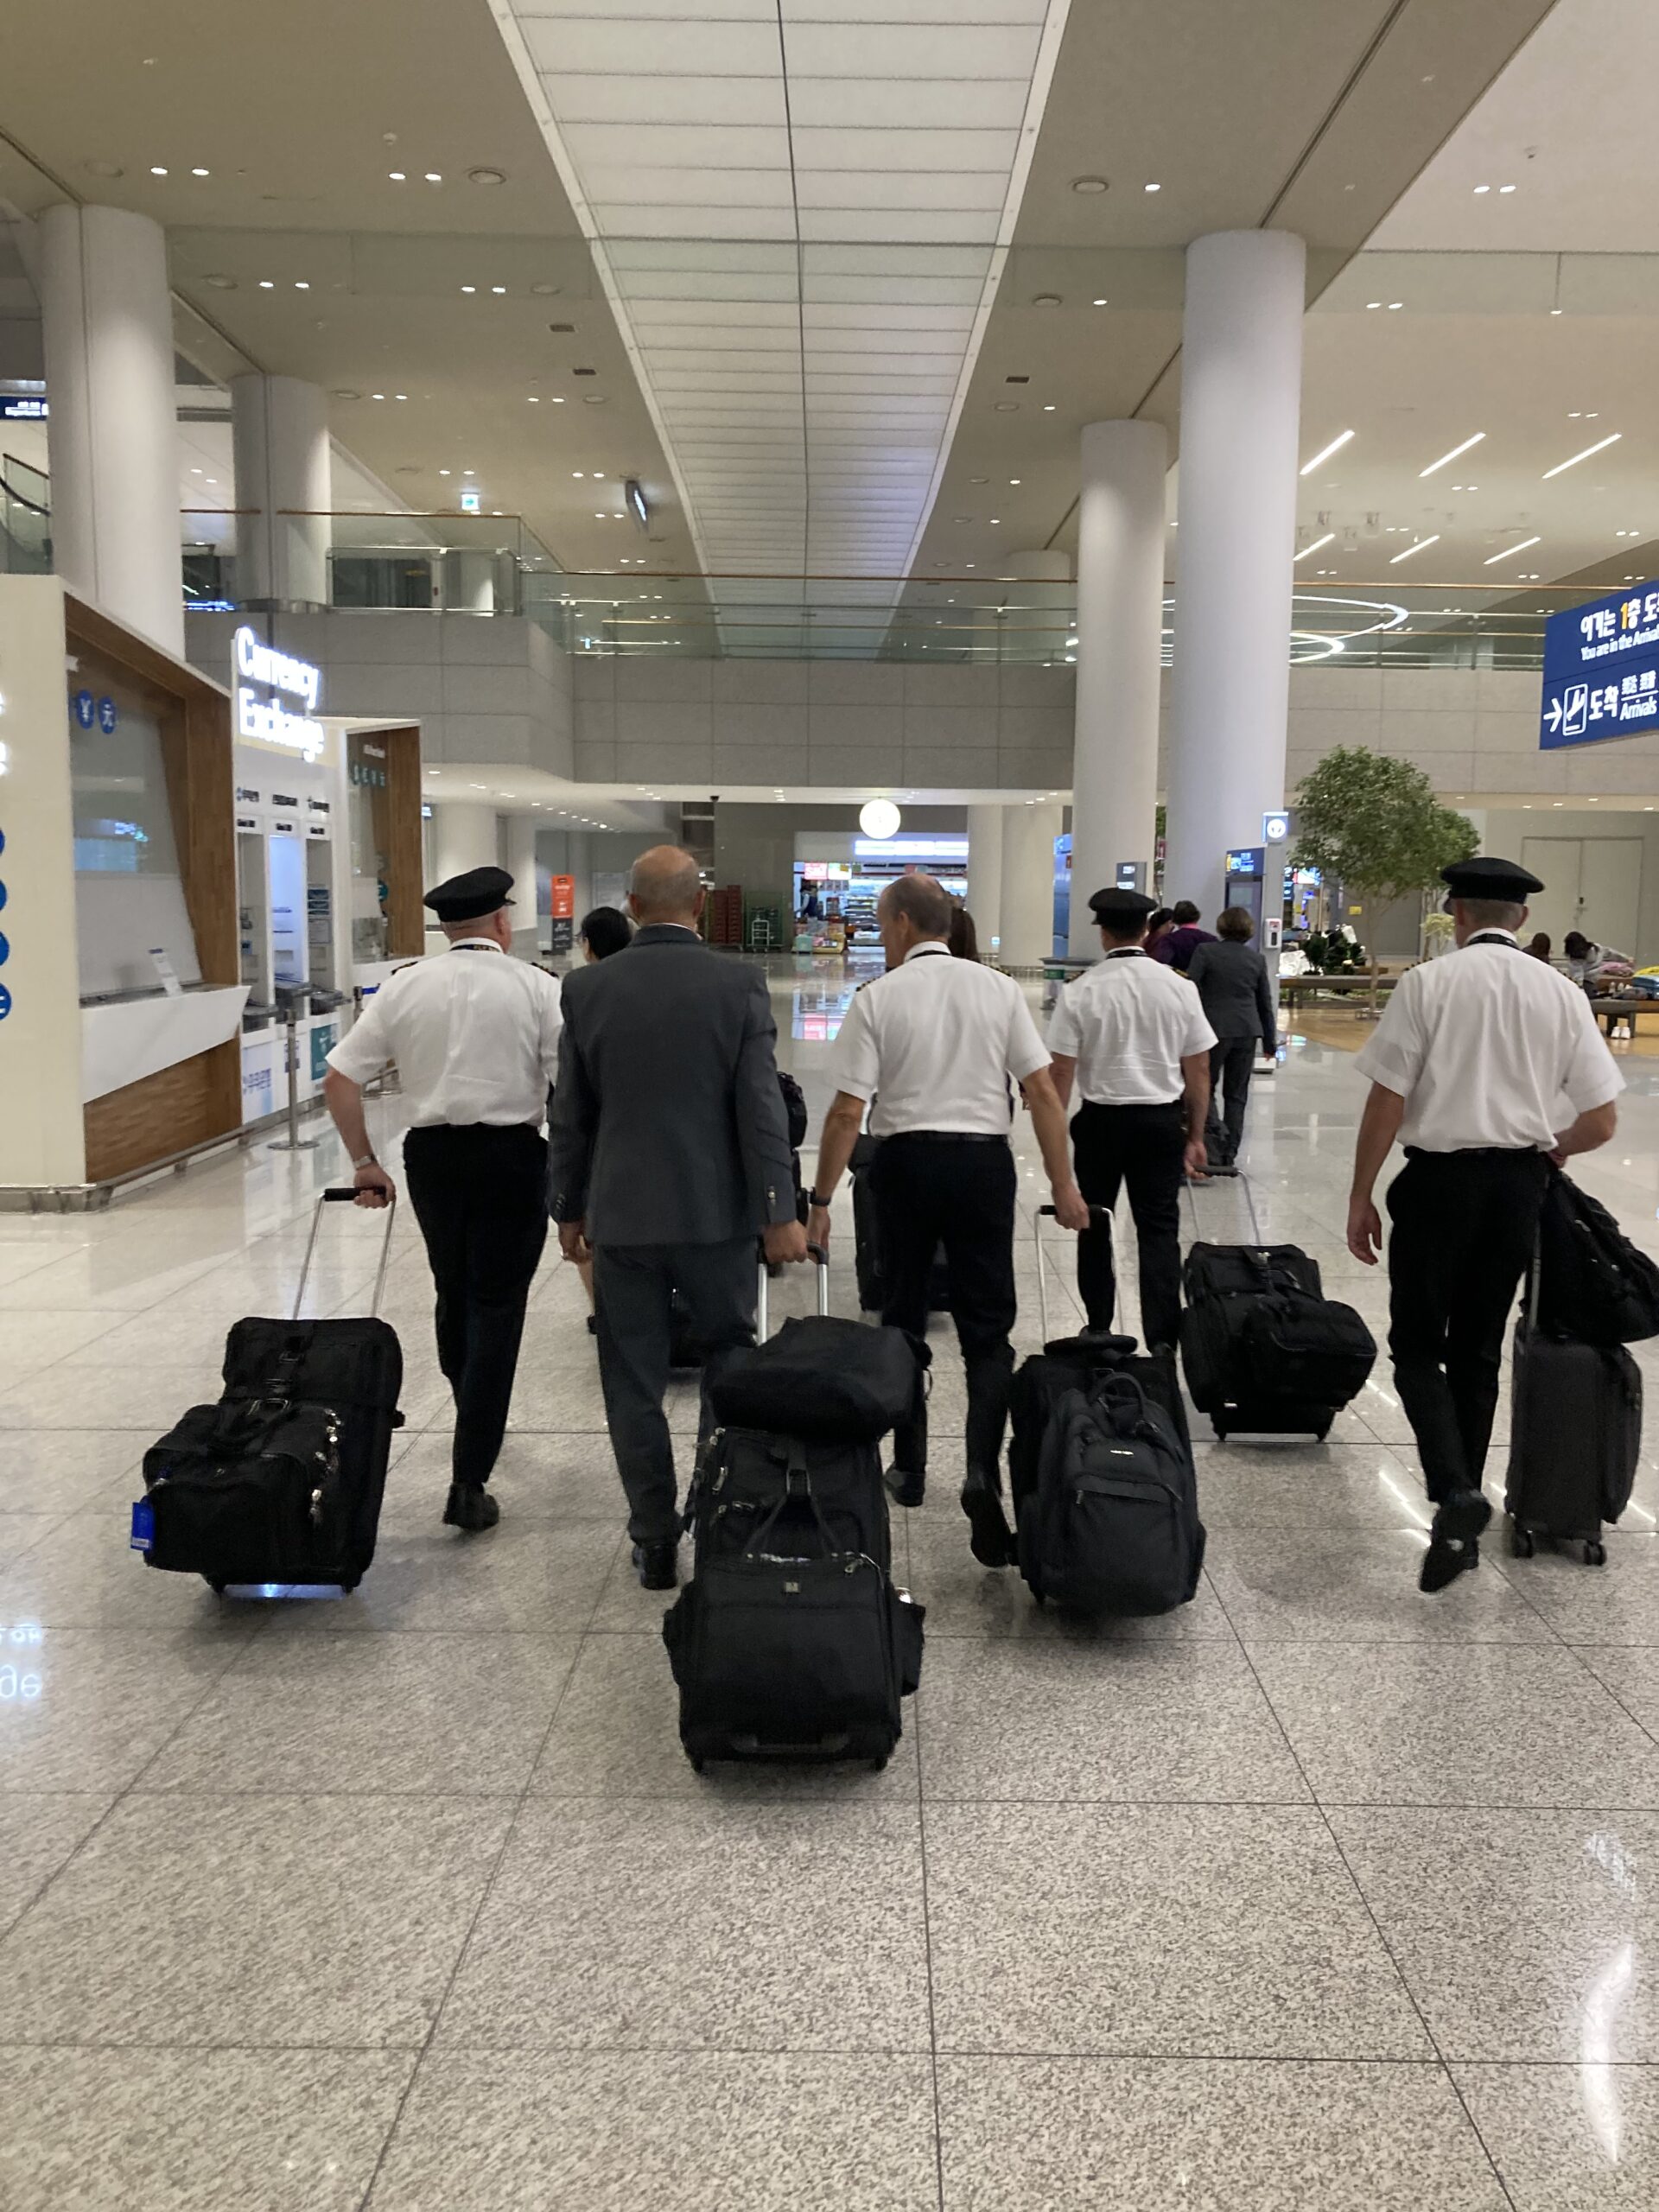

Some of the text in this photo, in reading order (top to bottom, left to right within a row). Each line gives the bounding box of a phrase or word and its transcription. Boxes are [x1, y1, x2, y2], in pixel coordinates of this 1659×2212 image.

[1580, 592, 1659, 642] 여기는 1층 도
[235, 626, 320, 710] Currency
[1580, 645, 1597, 661] You
[1596, 642, 1610, 657] are
[1609, 637, 1618, 653] in
[1618, 633, 1633, 651] the
[1588, 685, 1619, 721] 도착
[1619, 696, 1658, 721] Arrivals
[238, 687, 325, 764] Exchange
